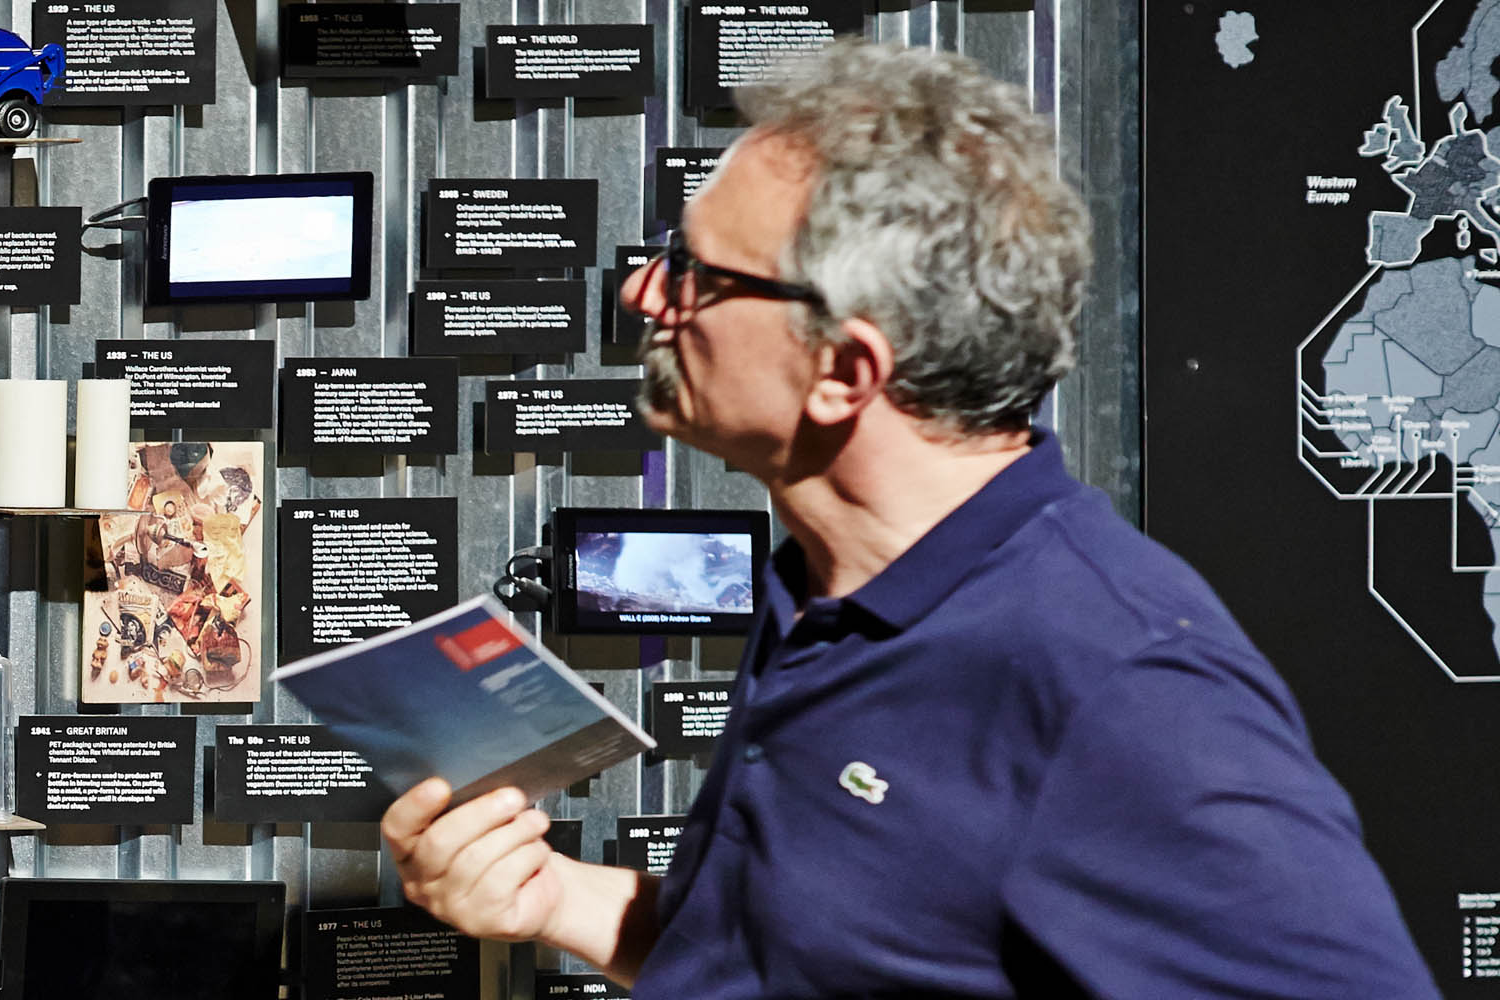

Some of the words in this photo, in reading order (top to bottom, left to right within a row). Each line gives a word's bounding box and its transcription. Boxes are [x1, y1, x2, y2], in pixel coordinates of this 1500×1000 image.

[84, 4, 101, 13] THE
[103, 4, 115, 13] US
[1306, 176, 1357, 190] Western
[473, 190, 508, 199] SWEDEN
[1306, 190, 1350, 206] Europe
[142, 351, 159, 360] THE
[161, 351, 172, 360] US
[331, 368, 356, 377] JAPAN
[294, 510, 314, 519] 1973
[329, 509, 345, 518] THE
[347, 509, 359, 518] US
[31, 727, 51, 735] 1941
[66, 727, 94, 735] GREAT
[96, 727, 127, 735] BRITAIN
[318, 922, 337, 931] 1977
[353, 920, 369, 928] THE
[370, 920, 382, 928] US
[583, 984, 607, 993] INDIA
